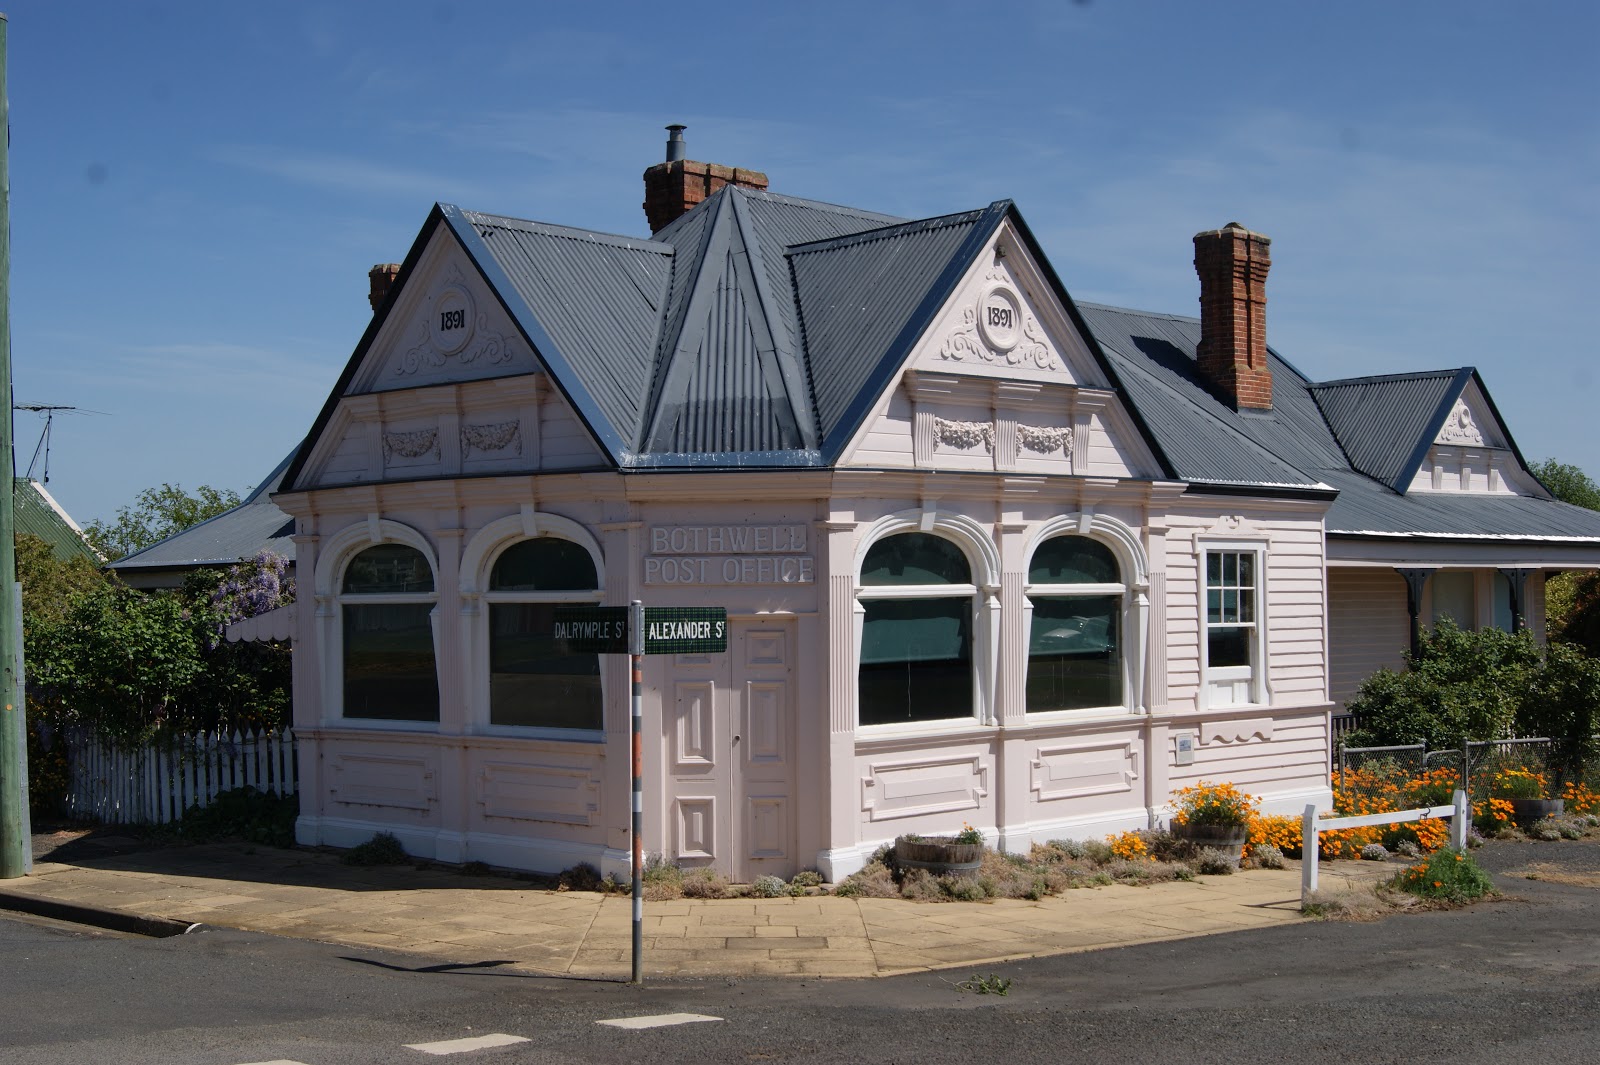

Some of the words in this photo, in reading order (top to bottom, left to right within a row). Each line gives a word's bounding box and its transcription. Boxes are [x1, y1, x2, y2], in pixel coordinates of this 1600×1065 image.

[441, 309, 465, 332] 1891
[987, 307, 1013, 329] 1891
[652, 526, 806, 553] BOTHWELL
[644, 558, 710, 584] POST
[722, 557, 814, 584] OFFICE
[555, 621, 610, 639] DALRYMPLE
[649, 621, 711, 640] ALEXANDER
